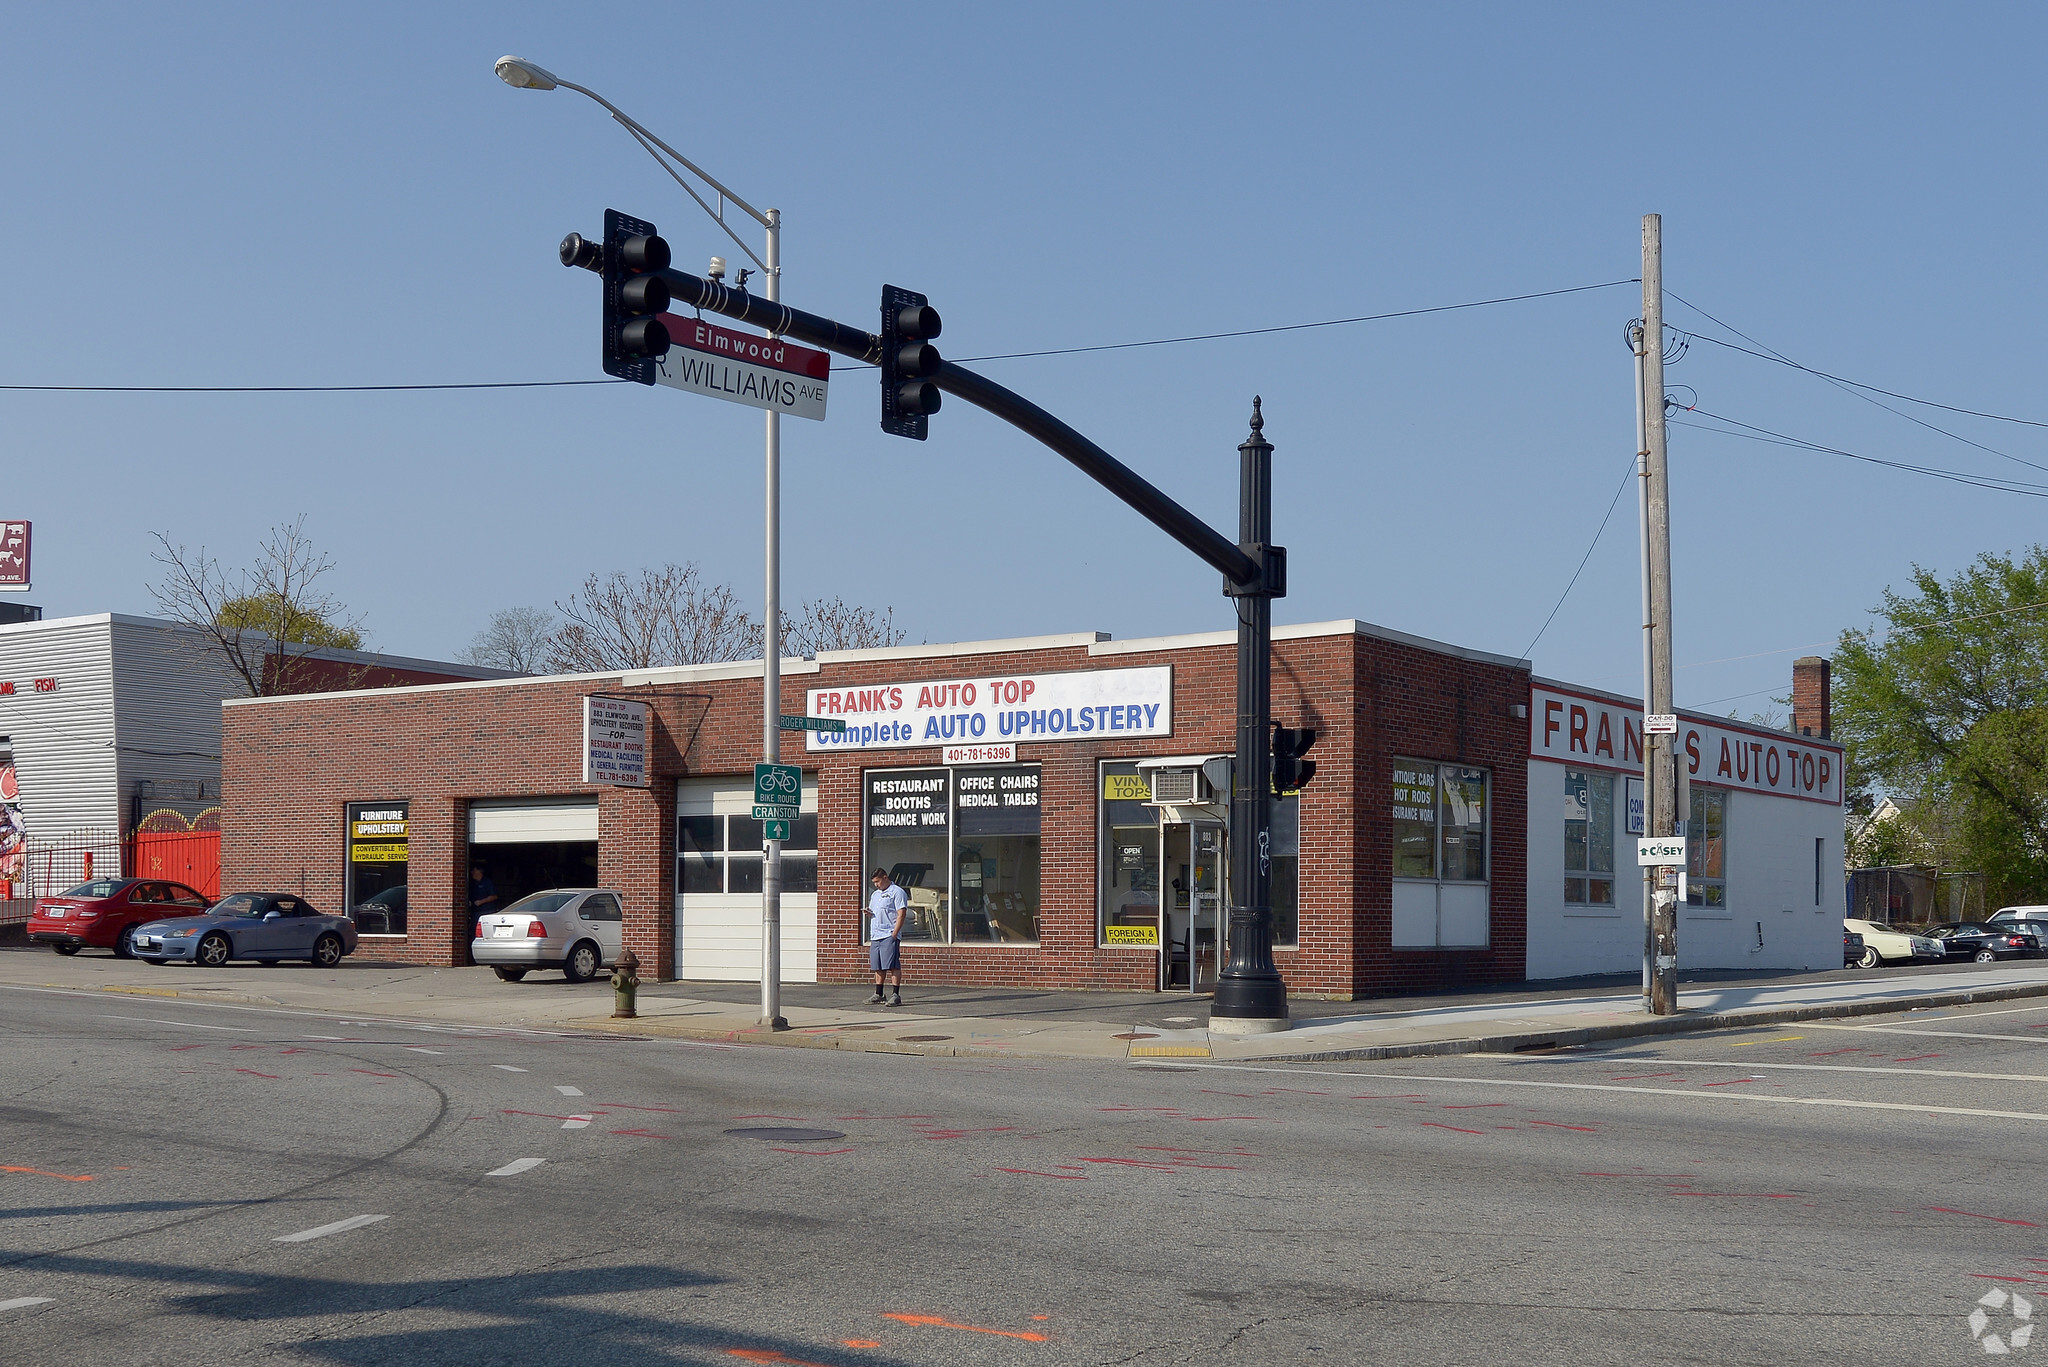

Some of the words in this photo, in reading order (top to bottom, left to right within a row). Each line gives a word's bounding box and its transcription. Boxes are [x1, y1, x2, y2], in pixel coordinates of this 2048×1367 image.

[695, 326, 785, 363] Elmwood
[682, 356, 796, 406] WILLIAMS
[799, 385, 824, 401] AVE
[0, 682, 14, 695] MB
[35, 678, 56, 692] FISH
[816, 686, 903, 714] FRANK'S
[918, 682, 977, 708] AUTO
[991, 680, 1035, 704] TOP
[607, 702, 617, 710] AUTO
[605, 711, 628, 720] ELMWOOD
[924, 712, 986, 739] AUTO
[999, 703, 1160, 736] UPHOLSTERY
[591, 718, 617, 729] UPHOLSTERY
[619, 721, 643, 731] RECOVERED
[780, 717, 803, 728] ROGER
[806, 718, 837, 730] WILLIAMS
[609, 731, 625, 739] FOR
[591, 739, 622, 750] RESTAURANT
[624, 743, 643, 752] BOOTHS
[1544, 700, 1700, 774] FRAN'S
[1717, 737, 1780, 787] AUTO
[1787, 750, 1830, 793] TOP
[591, 750, 613, 759] MEDICAL
[616, 752, 642, 762] FACILITIES
[948, 747, 1010, 761] 401-781-6396
[597, 761, 617, 770] GENERAL
[619, 763, 643, 772] FURNITURE
[873, 779, 944, 793] RESTAURANT
[960, 777, 994, 790] OFFICE
[1000, 775, 1038, 790] CHAIRS
[1113, 777, 1145, 786] VINY
[1418, 772, 1435, 787] CARS
[760, 794, 774, 802] BIKE
[777, 794, 796, 804] ROUTE
[1114, 788, 1152, 797] TOPS
[1394, 788, 1408, 801] HOT
[1412, 790, 1430, 804] RODS
[886, 796, 931, 810] BOOTHS
[959, 794, 998, 807] MEDICAL
[1003, 792, 1038, 806] TABLES
[360, 811, 403, 820] FURNITURE
[755, 807, 798, 818] CRANSTON
[1393, 806, 1418, 820] SURANCE
[1419, 808, 1434, 822] WORK
[871, 814, 917, 827] INSURANCE
[921, 812, 946, 825] WORK
[358, 824, 405, 834] UPHOLSTERY
[1650, 842, 1684, 859] CASEY
[1109, 930, 1145, 938] FOREIGN
[1148, 930, 1154, 938] &
